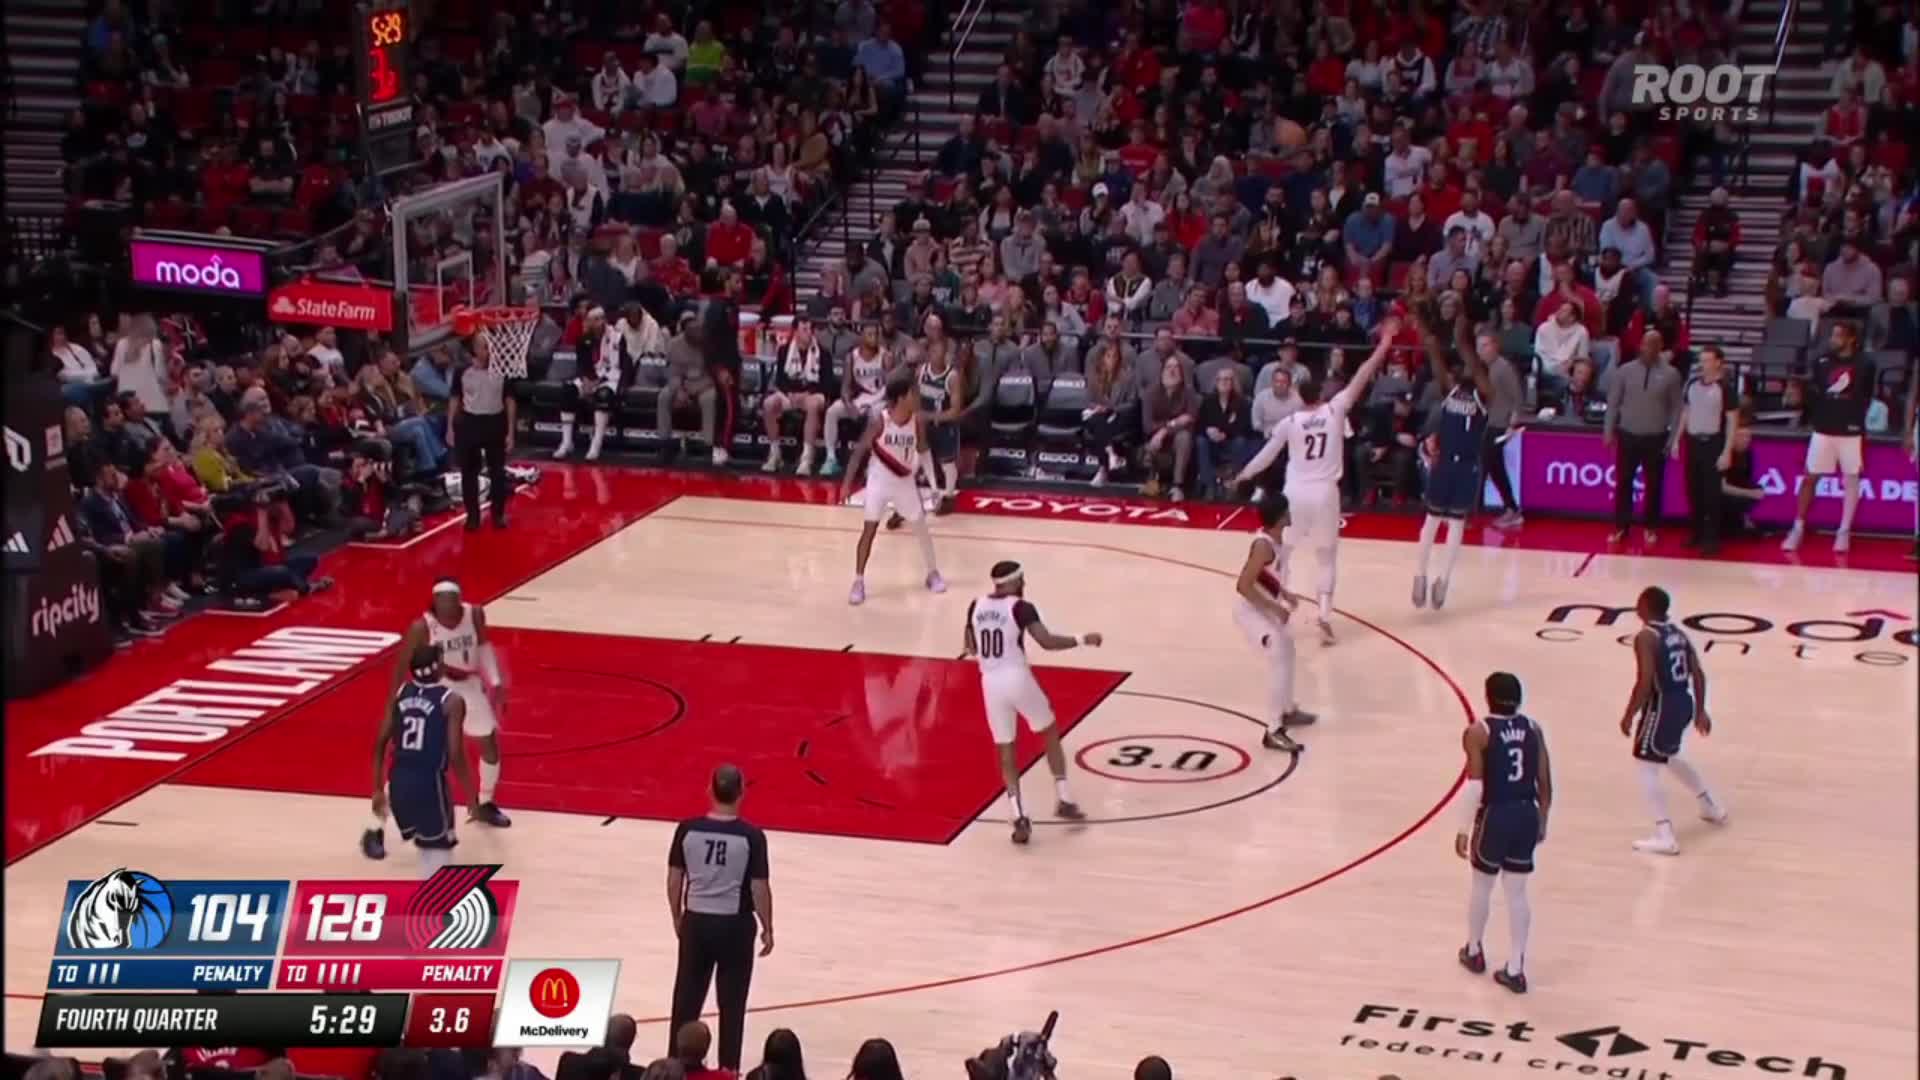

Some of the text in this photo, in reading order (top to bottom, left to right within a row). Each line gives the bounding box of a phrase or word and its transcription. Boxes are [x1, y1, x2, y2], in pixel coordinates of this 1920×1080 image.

[156, 255, 240, 289] moda
[1038, 451, 1079, 464] GEICO
[1305, 433, 1328, 460] 27
[973, 497, 1189, 521] TOYOTA
[32, 581, 100, 638] ripcity
[981, 628, 1003, 659] 00
[27, 627, 403, 762] PORTLAND
[402, 716, 426, 751] 21
[1108, 745, 1218, 772] 3.0
[1508, 747, 1524, 782] 3
[1340, 1034, 1688, 1080] federal credit
[1353, 1004, 1849, 1080] First Tech
